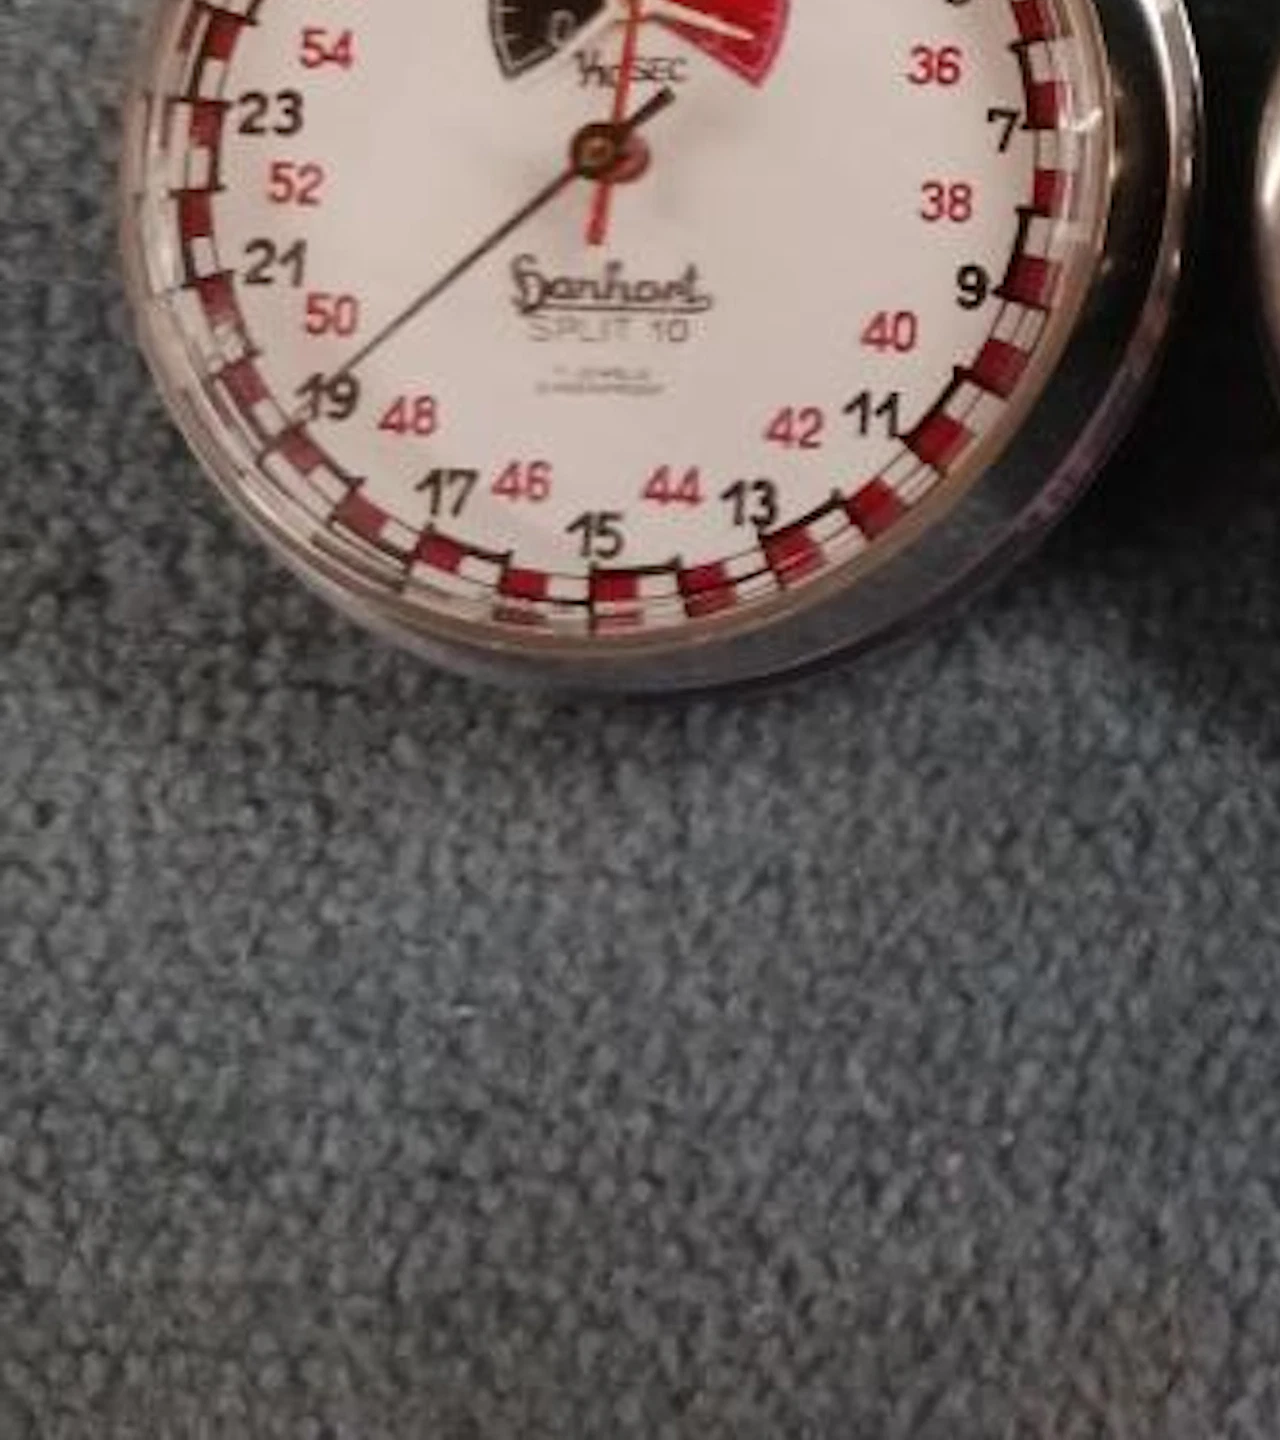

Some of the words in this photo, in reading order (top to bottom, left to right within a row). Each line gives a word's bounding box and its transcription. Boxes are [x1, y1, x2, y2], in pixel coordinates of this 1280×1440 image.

[301, 29, 353, 68] 54
[907, 46, 962, 85] 36
[238, 91, 303, 135] 23
[987, 108, 1019, 152] 7
[267, 162, 323, 204] 52
[921, 182, 972, 222] 38
[245, 239, 307, 287] 21
[956, 265, 988, 310] 9
[306, 292, 357, 335] 50
[649, 317, 689, 343] 10
[861, 310, 917, 352] 40
[295, 372, 360, 420] 19
[379, 396, 437, 434] 48
[843, 391, 902, 436] 11
[764, 407, 825, 449] 42
[415, 468, 478, 517] 17
[491, 462, 551, 501] 46
[643, 467, 703, 505] 44
[719, 480, 778, 527] 13
[565, 512, 625, 558] 15
